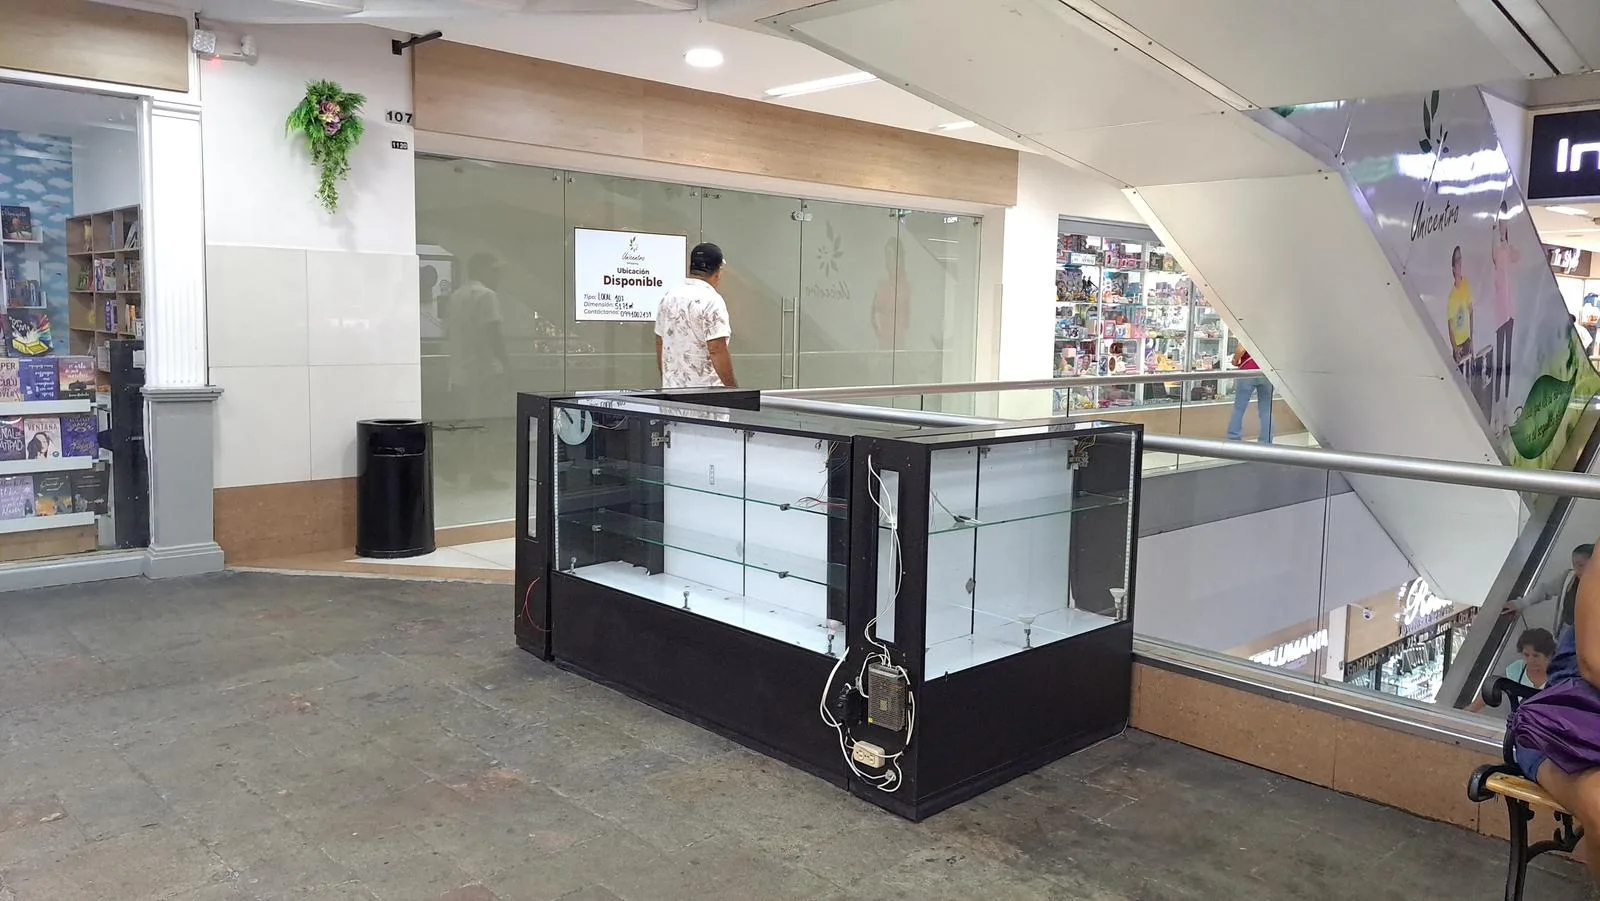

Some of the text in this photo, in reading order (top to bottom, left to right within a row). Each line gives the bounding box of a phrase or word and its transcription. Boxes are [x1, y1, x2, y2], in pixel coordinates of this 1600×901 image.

[386, 110, 413, 123] 107
[1556, 138, 1600, 172] In
[1411, 200, 1459, 241] Unicentro
[617, 267, 650, 275] Ubicación
[603, 274, 663, 288] Disponible
